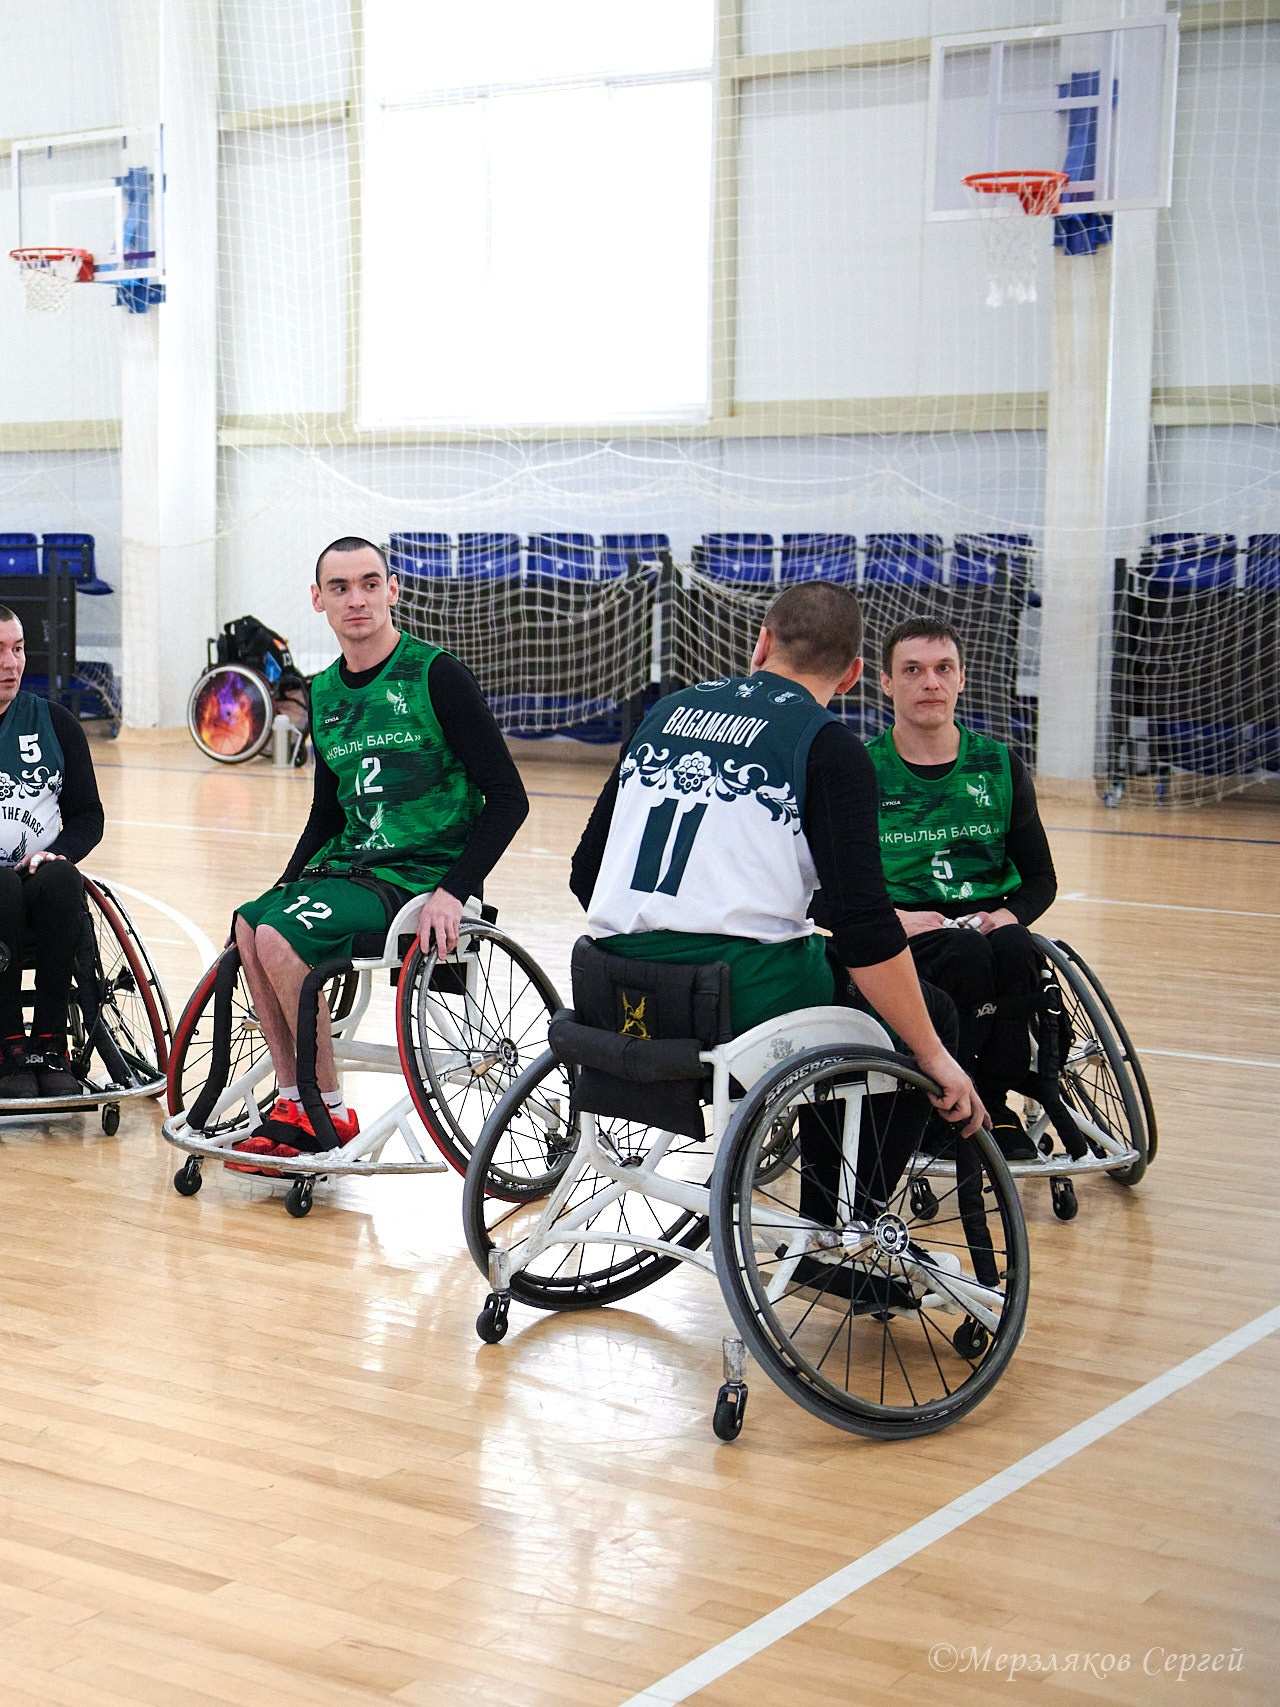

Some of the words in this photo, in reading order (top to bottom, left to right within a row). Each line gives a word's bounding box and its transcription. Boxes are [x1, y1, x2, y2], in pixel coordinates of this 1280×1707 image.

[661, 706, 769, 748] BAGAMANOV
[18, 733, 42, 763] 5
[326, 740, 363, 760] «КРЫЛЬ
[366, 732, 421, 746] БАРСА»
[1, 806, 21, 821] THE
[20, 809, 45, 838] BARSE
[951, 823, 1000, 838] БАРСА»
[629, 797, 709, 897] 11
[931, 849, 954, 879] 5
[283, 895, 333, 930] 12
